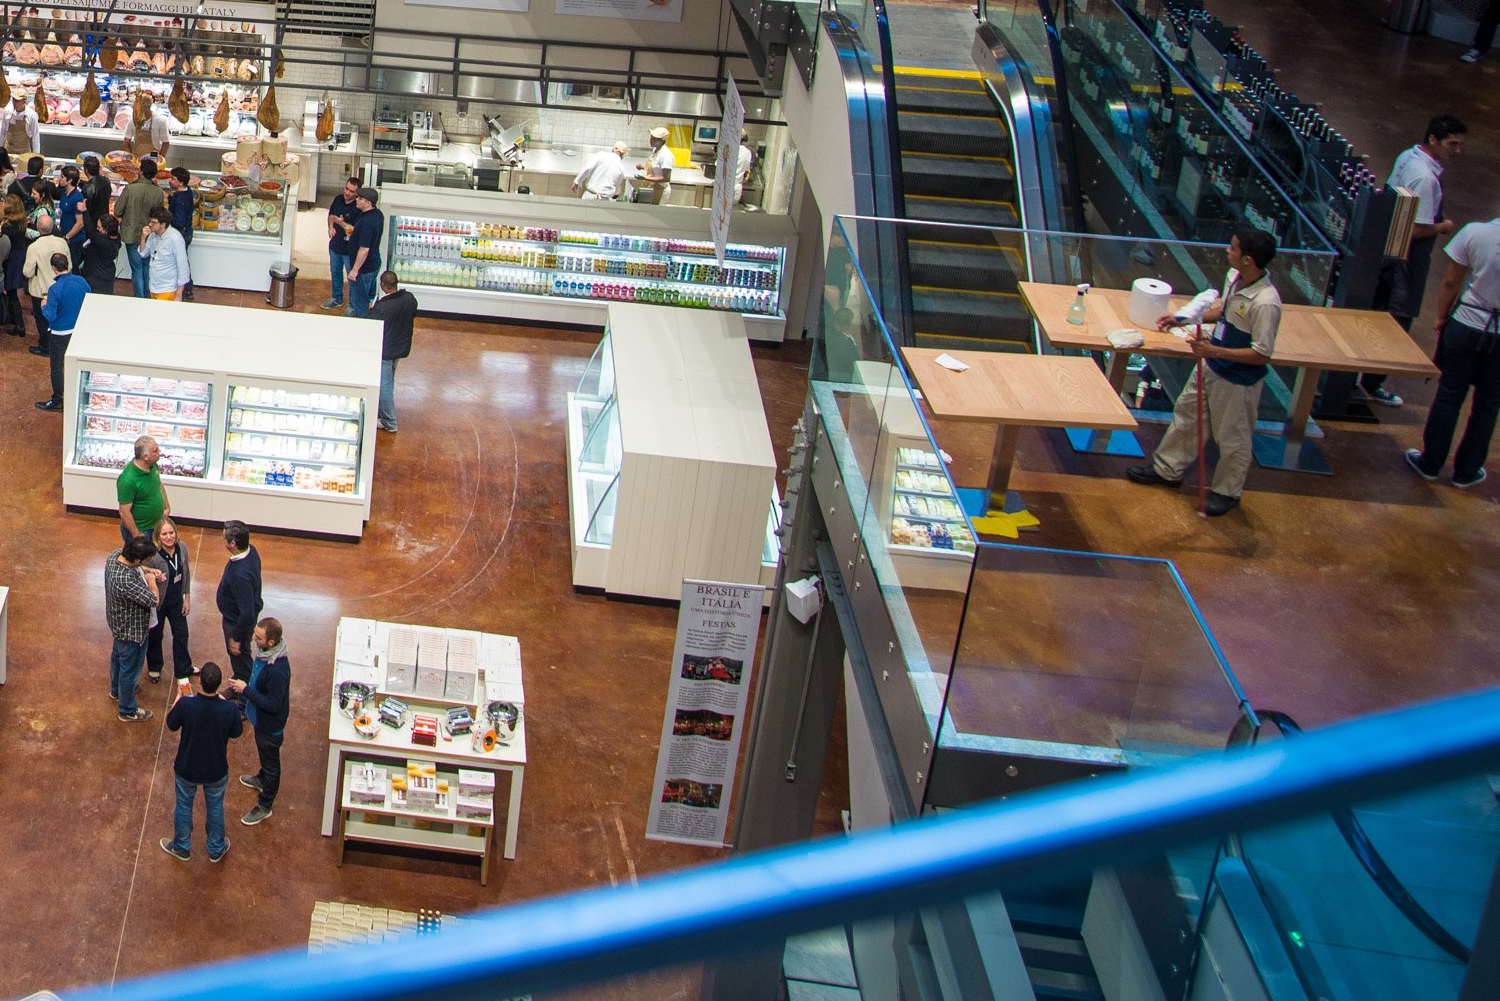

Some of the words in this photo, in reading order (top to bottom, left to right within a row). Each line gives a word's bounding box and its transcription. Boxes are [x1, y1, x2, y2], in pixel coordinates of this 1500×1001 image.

[114, 0, 120, 9] E
[123, 1, 179, 13] FORMAGGI
[182, 5, 193, 14] DI
[199, 7, 237, 17] ATALY
[697, 585, 740, 598] BRASIL
[743, 589, 751, 599] E
[702, 619, 736, 630] FESTAS
